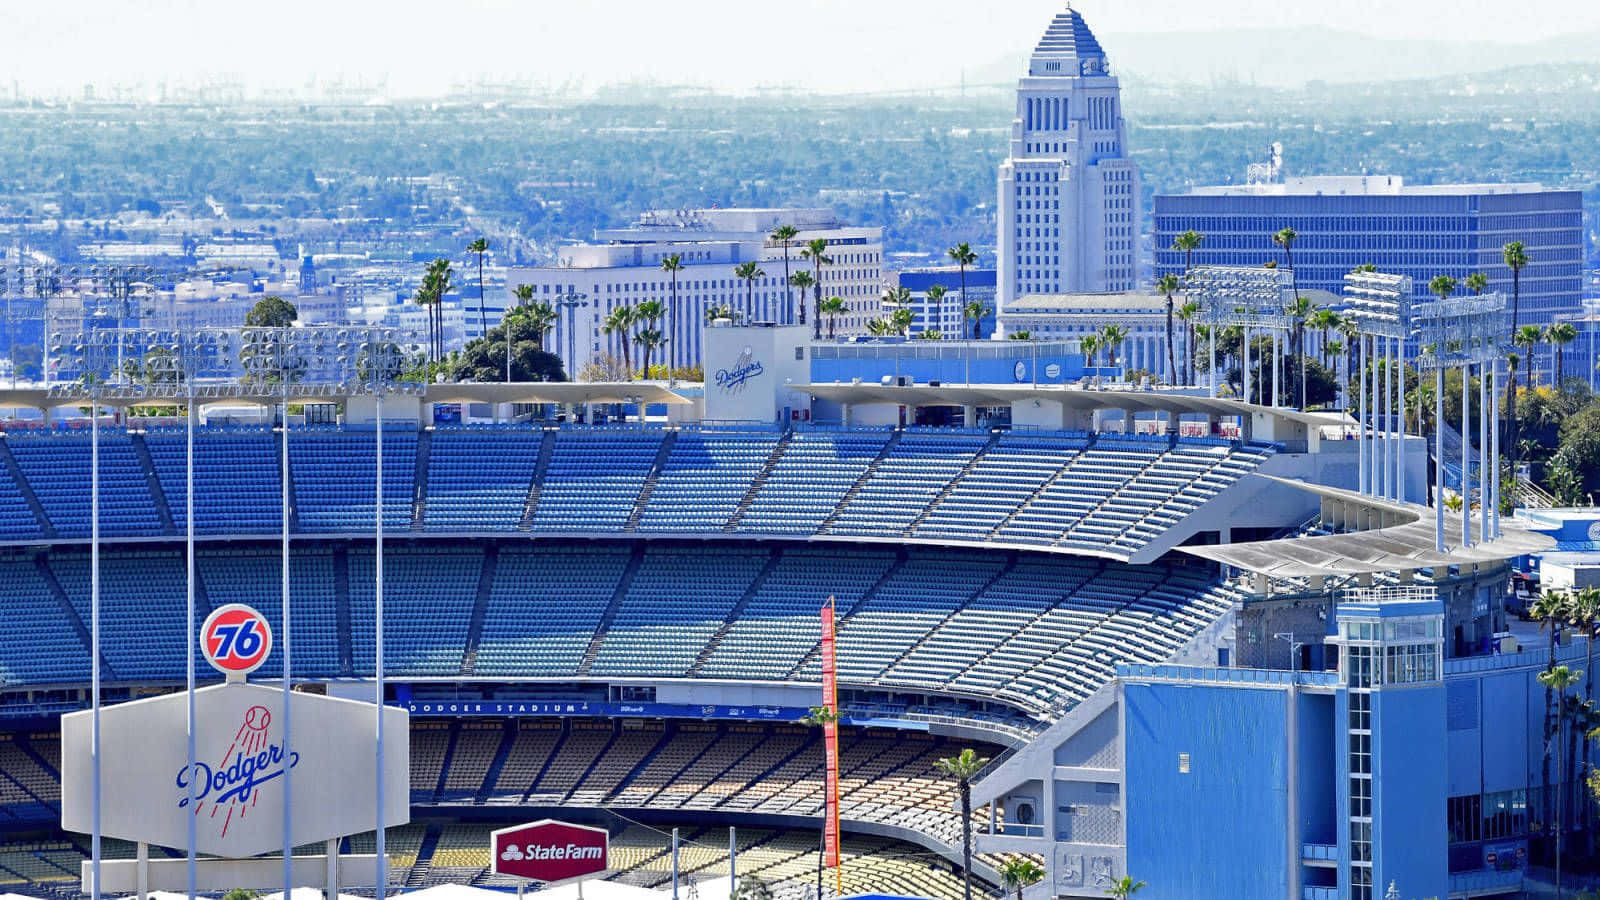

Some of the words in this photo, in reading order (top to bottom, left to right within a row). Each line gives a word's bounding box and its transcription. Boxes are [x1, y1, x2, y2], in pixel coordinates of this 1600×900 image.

[715, 360, 764, 388] Dodgers
[212, 619, 263, 659] 76
[409, 704, 481, 713] DODGER
[496, 704, 575, 713] STADIUM
